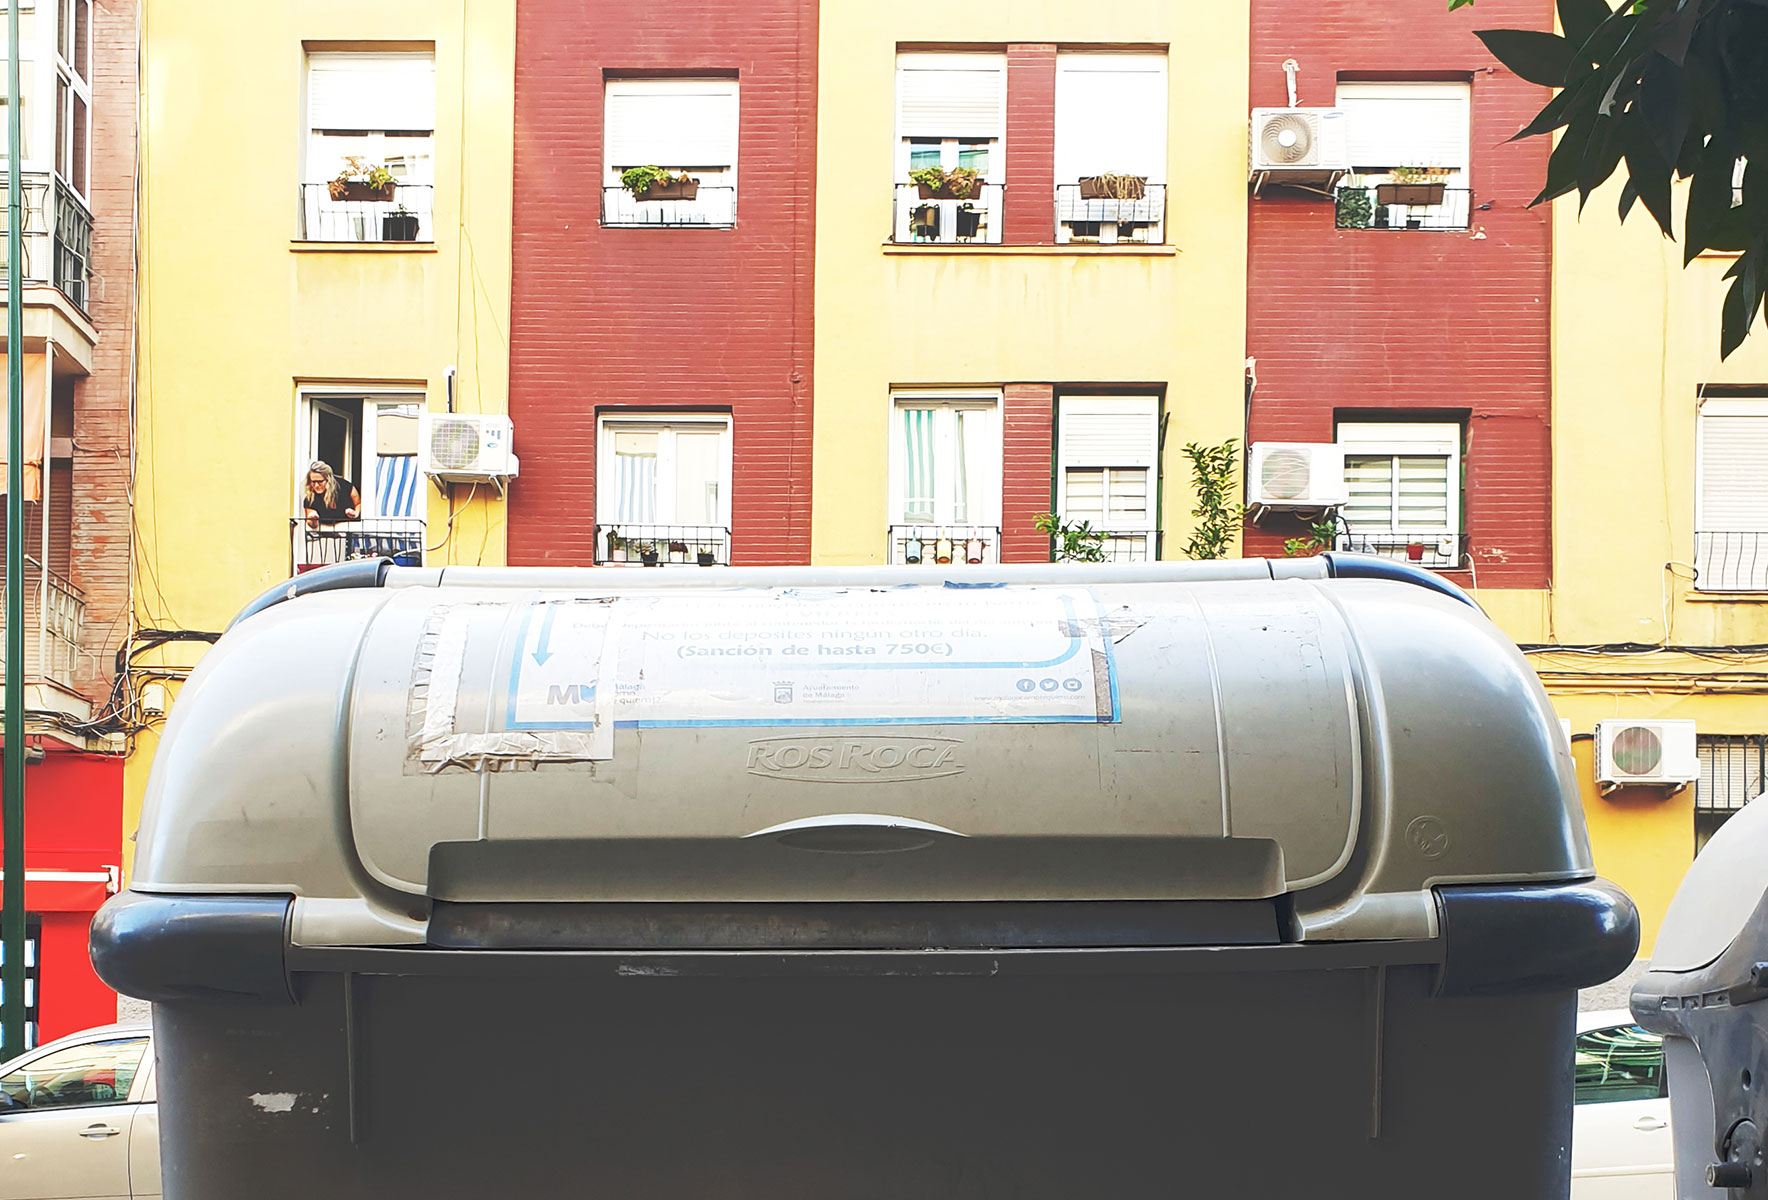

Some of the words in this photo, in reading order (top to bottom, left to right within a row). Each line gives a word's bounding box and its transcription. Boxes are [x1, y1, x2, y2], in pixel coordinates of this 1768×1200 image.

[642, 631, 675, 641] No
[684, 630, 711, 641] los
[718, 629, 813, 642] deposites
[822, 629, 891, 642] ningún
[899, 629, 943, 639] otro
[677, 644, 772, 660] (Sanción
[781, 644, 809, 656] de
[818, 644, 876, 656] hasta
[886, 643, 953, 657] 750€)
[747, 743, 833, 771] ROS
[839, 742, 965, 773] ROCA
